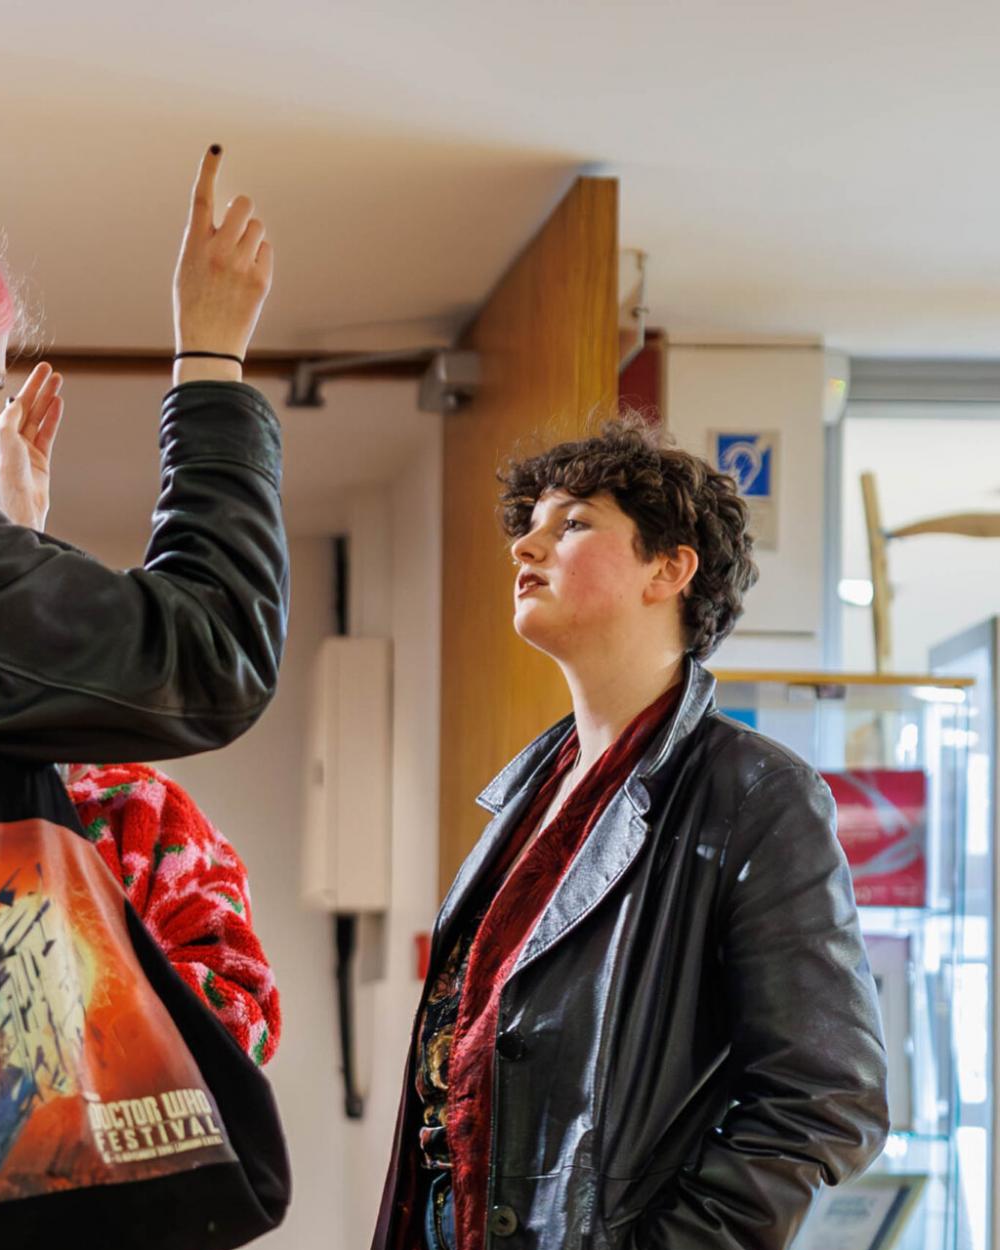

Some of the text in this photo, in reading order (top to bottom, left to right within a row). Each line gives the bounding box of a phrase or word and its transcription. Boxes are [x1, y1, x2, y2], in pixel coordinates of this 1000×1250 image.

[88, 1088, 212, 1131] DOCTOR WHO
[94, 1115, 221, 1151] FESTIVAL
